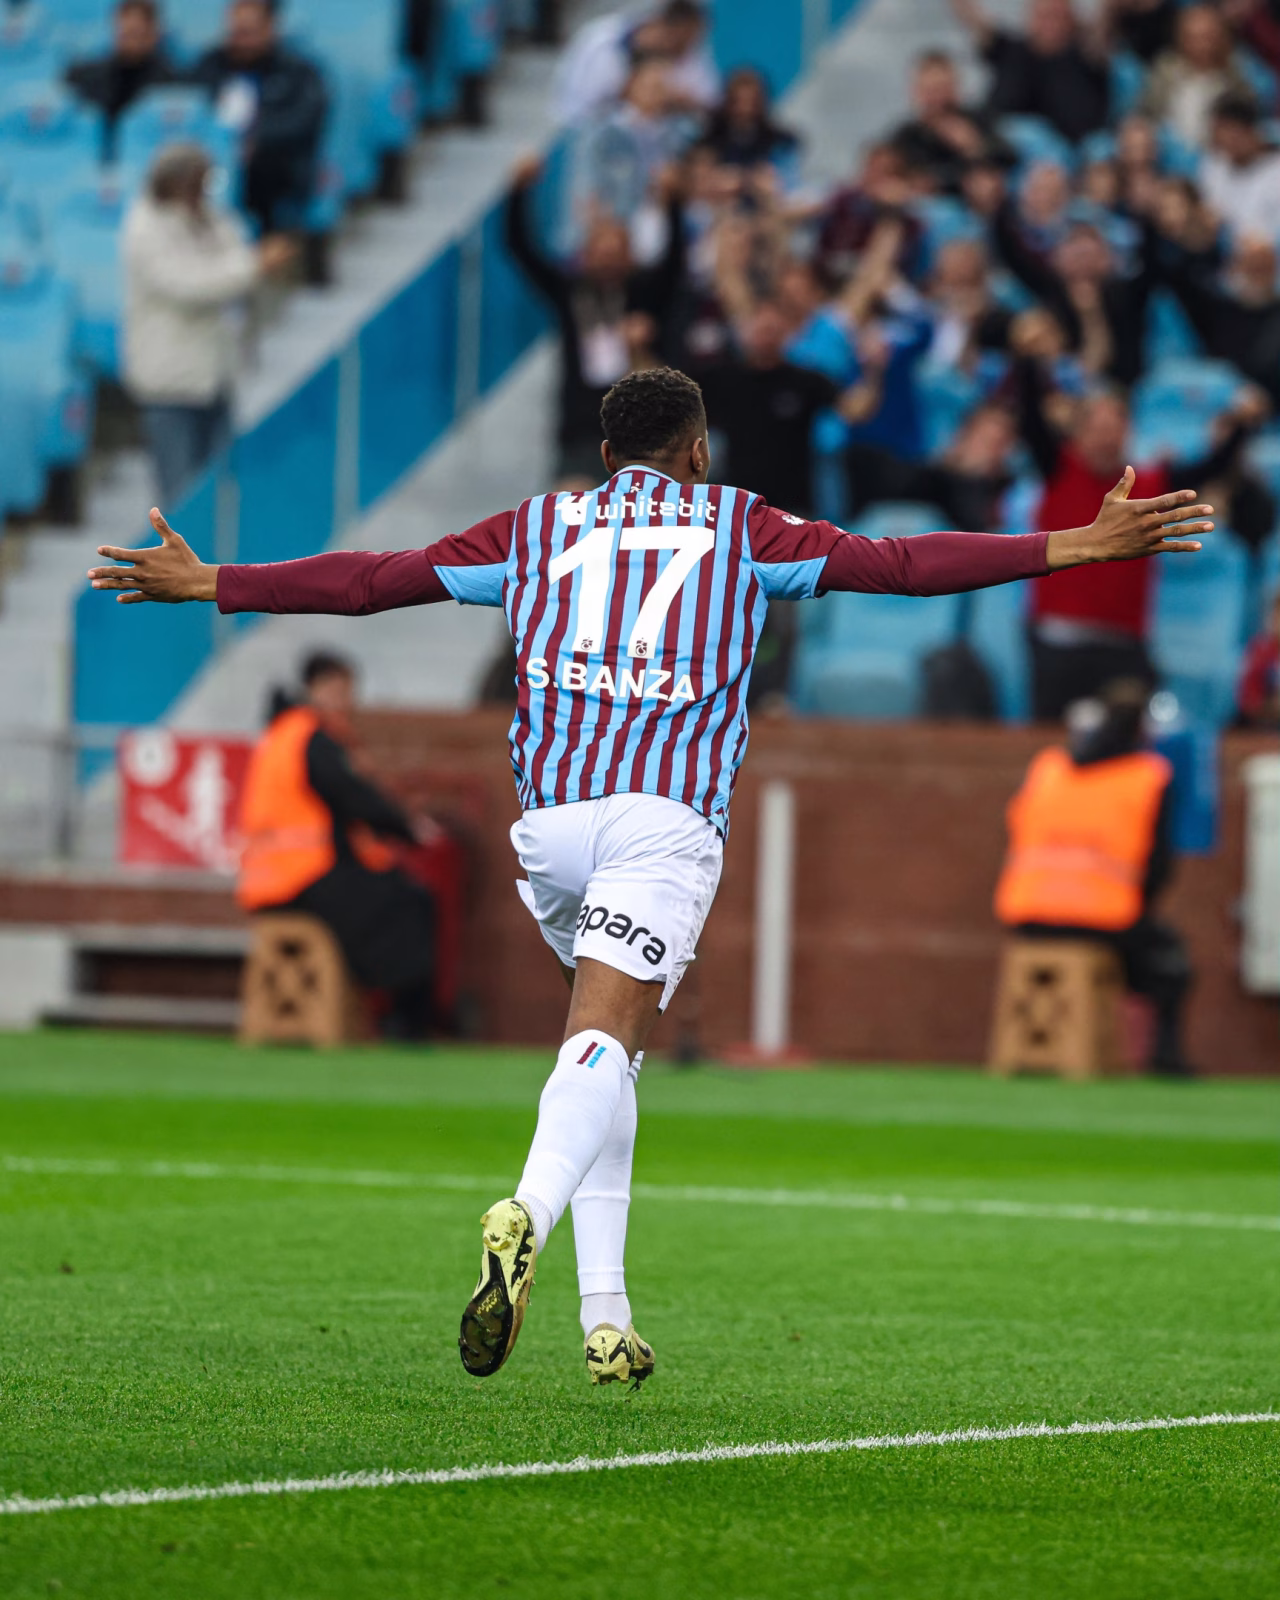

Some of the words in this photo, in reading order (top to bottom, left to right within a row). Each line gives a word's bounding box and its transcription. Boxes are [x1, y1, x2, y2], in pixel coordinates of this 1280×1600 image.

[595, 495, 717, 522] whitebit
[549, 526, 716, 659] 17
[526, 657, 696, 701] S.BANZA
